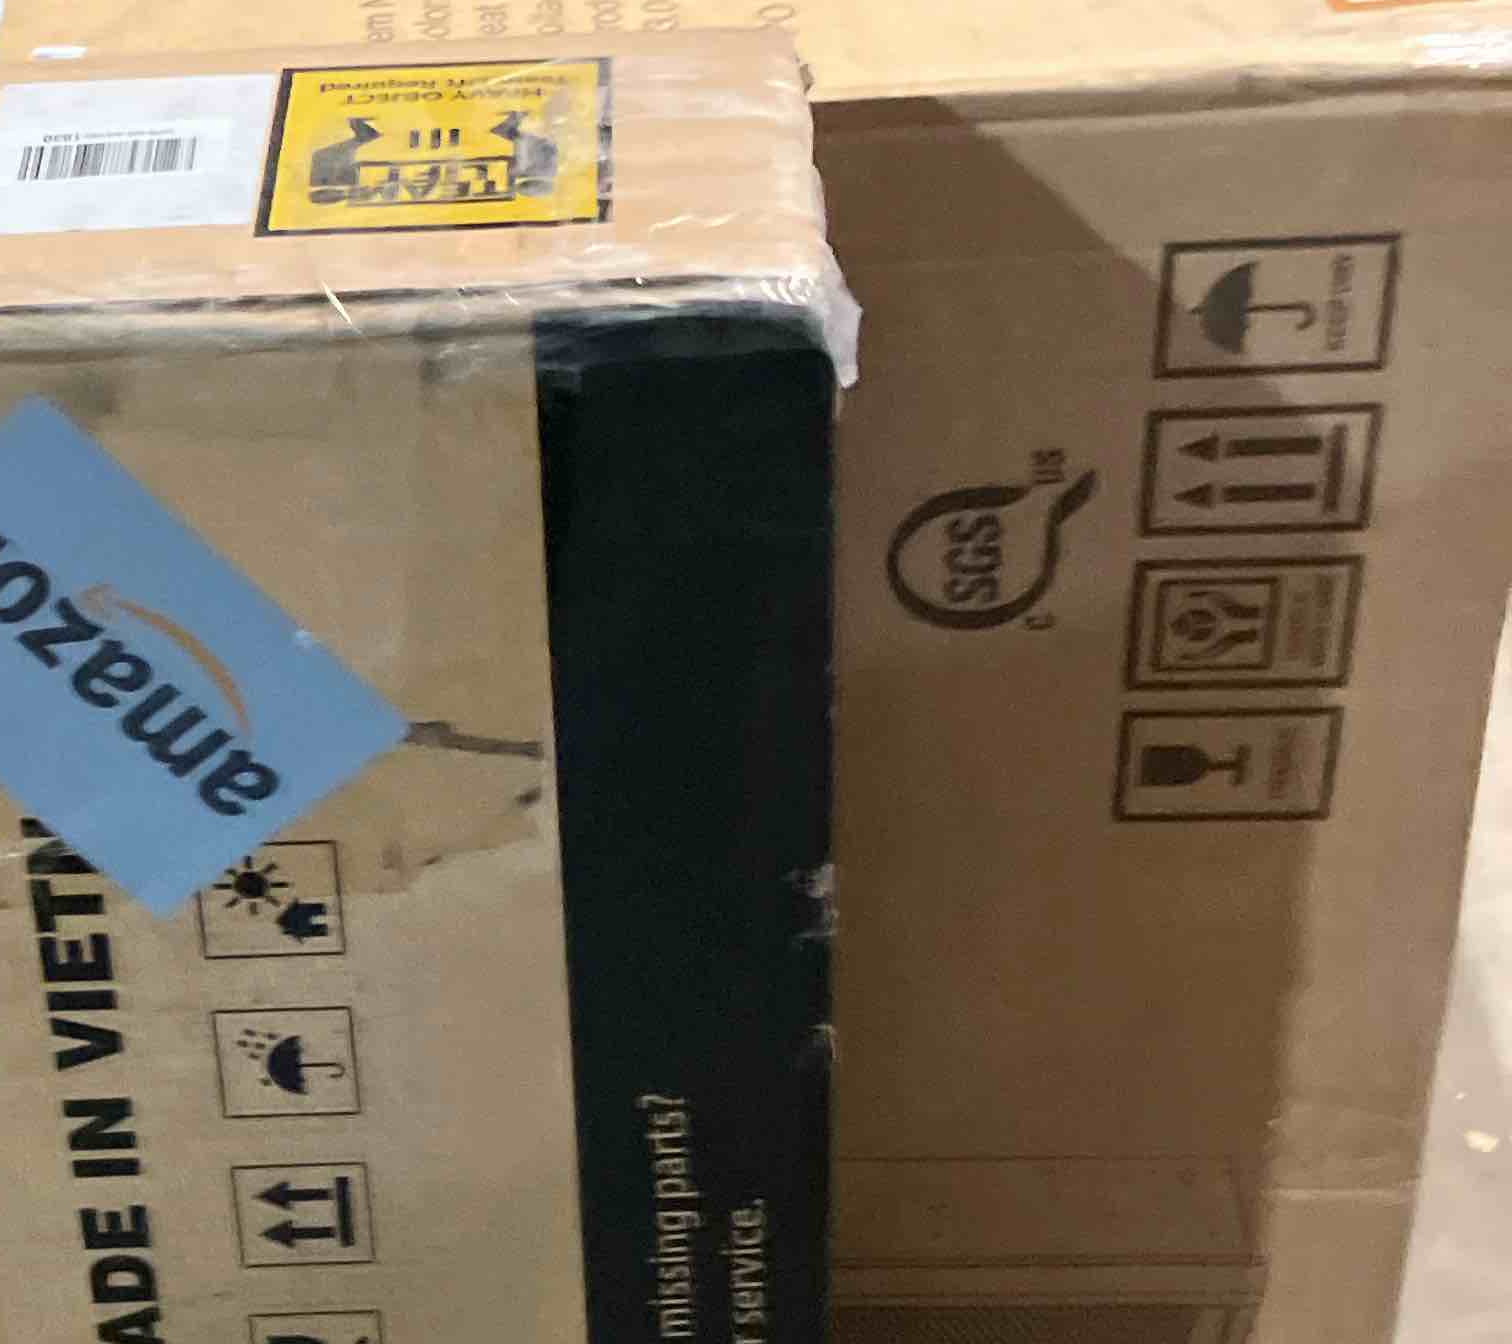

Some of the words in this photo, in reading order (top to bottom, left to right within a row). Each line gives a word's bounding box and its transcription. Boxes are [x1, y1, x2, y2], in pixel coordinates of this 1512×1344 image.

[367, 13, 394, 43] em
[475, 4, 506, 35] eat
[319, 78, 437, 94] Required
[342, 89, 443, 105] OBJECT
[942, 514, 1003, 605] SGS
[62, 1095, 141, 1179] IN
[636, 1094, 702, 1199] parts?
[645, 1209, 703, 1339] missing
